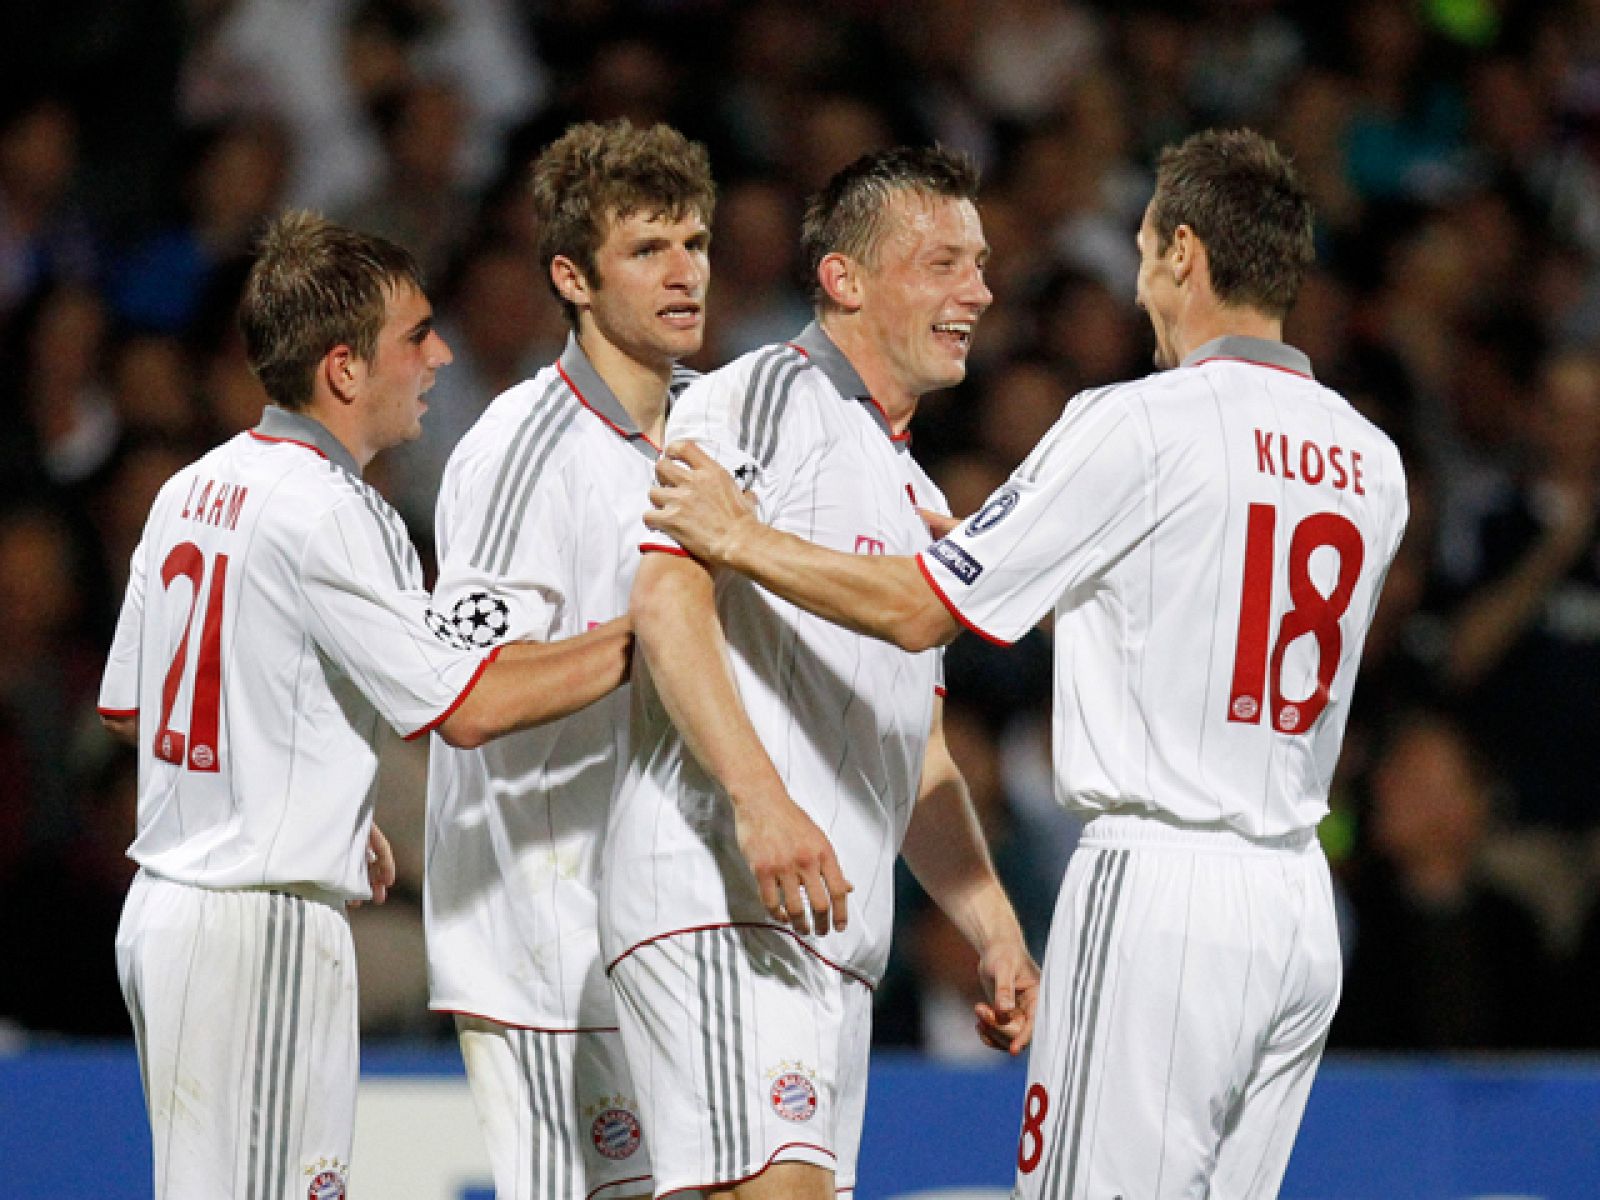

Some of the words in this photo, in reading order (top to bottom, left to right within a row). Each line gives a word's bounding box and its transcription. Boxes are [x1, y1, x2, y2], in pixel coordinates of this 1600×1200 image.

[182, 476, 248, 530] LAHM
[1254, 428, 1366, 496] KLOSE
[154, 541, 230, 773] 21
[1227, 502, 1365, 736] 18
[1018, 1082, 1049, 1175] 8
